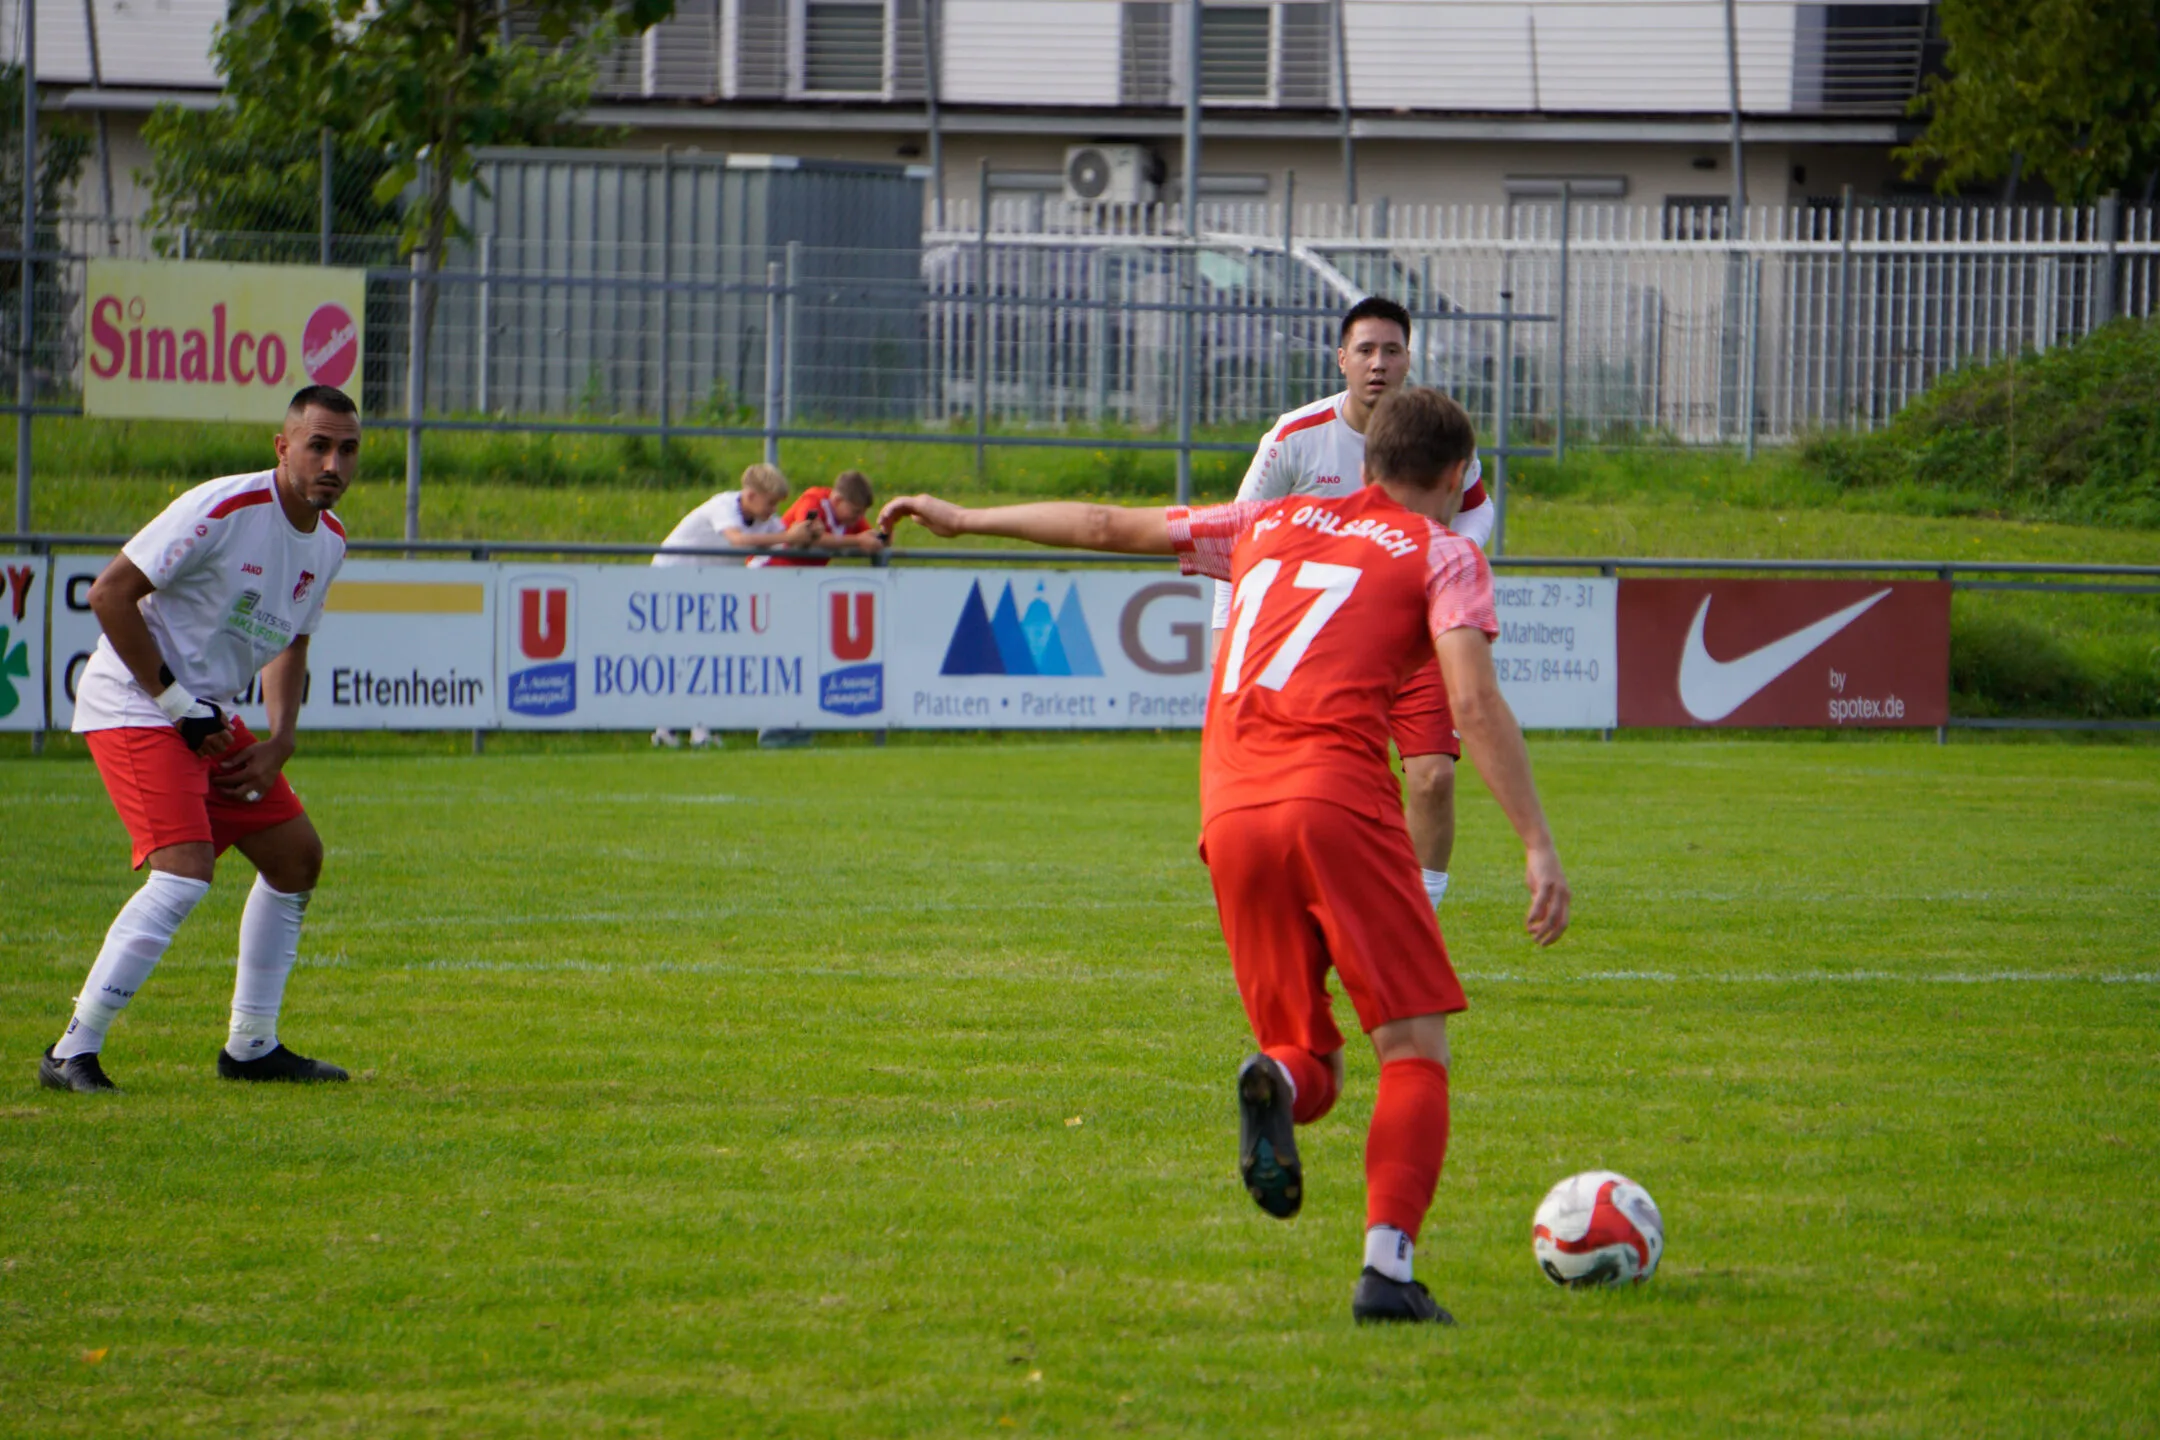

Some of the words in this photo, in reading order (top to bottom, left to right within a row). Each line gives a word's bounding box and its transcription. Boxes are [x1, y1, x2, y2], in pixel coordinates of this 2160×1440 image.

[89, 294, 287, 386] Sinalco
[1316, 475, 1341, 485] JAKO
[1291, 505, 1419, 559] OHLSBACH
[241, 562, 263, 576] JAKO
[0, 564, 35, 623] Y
[627, 591, 739, 634] SUPER
[749, 592, 771, 635] U
[1541, 583, 1561, 607] 29
[1576, 583, 1594, 608] 31
[520, 588, 568, 659] U
[829, 591, 875, 661] U
[1221, 557, 1363, 695] 17
[1502, 622, 1575, 651] Mahlberg
[332, 667, 483, 706] Ettenheim
[593, 653, 803, 697] BOOFZHEIM
[1829, 667, 1846, 693] by
[913, 691, 990, 716] Platten
[1021, 691, 1096, 716] Parkett
[1829, 694, 1905, 724] spotex.de
